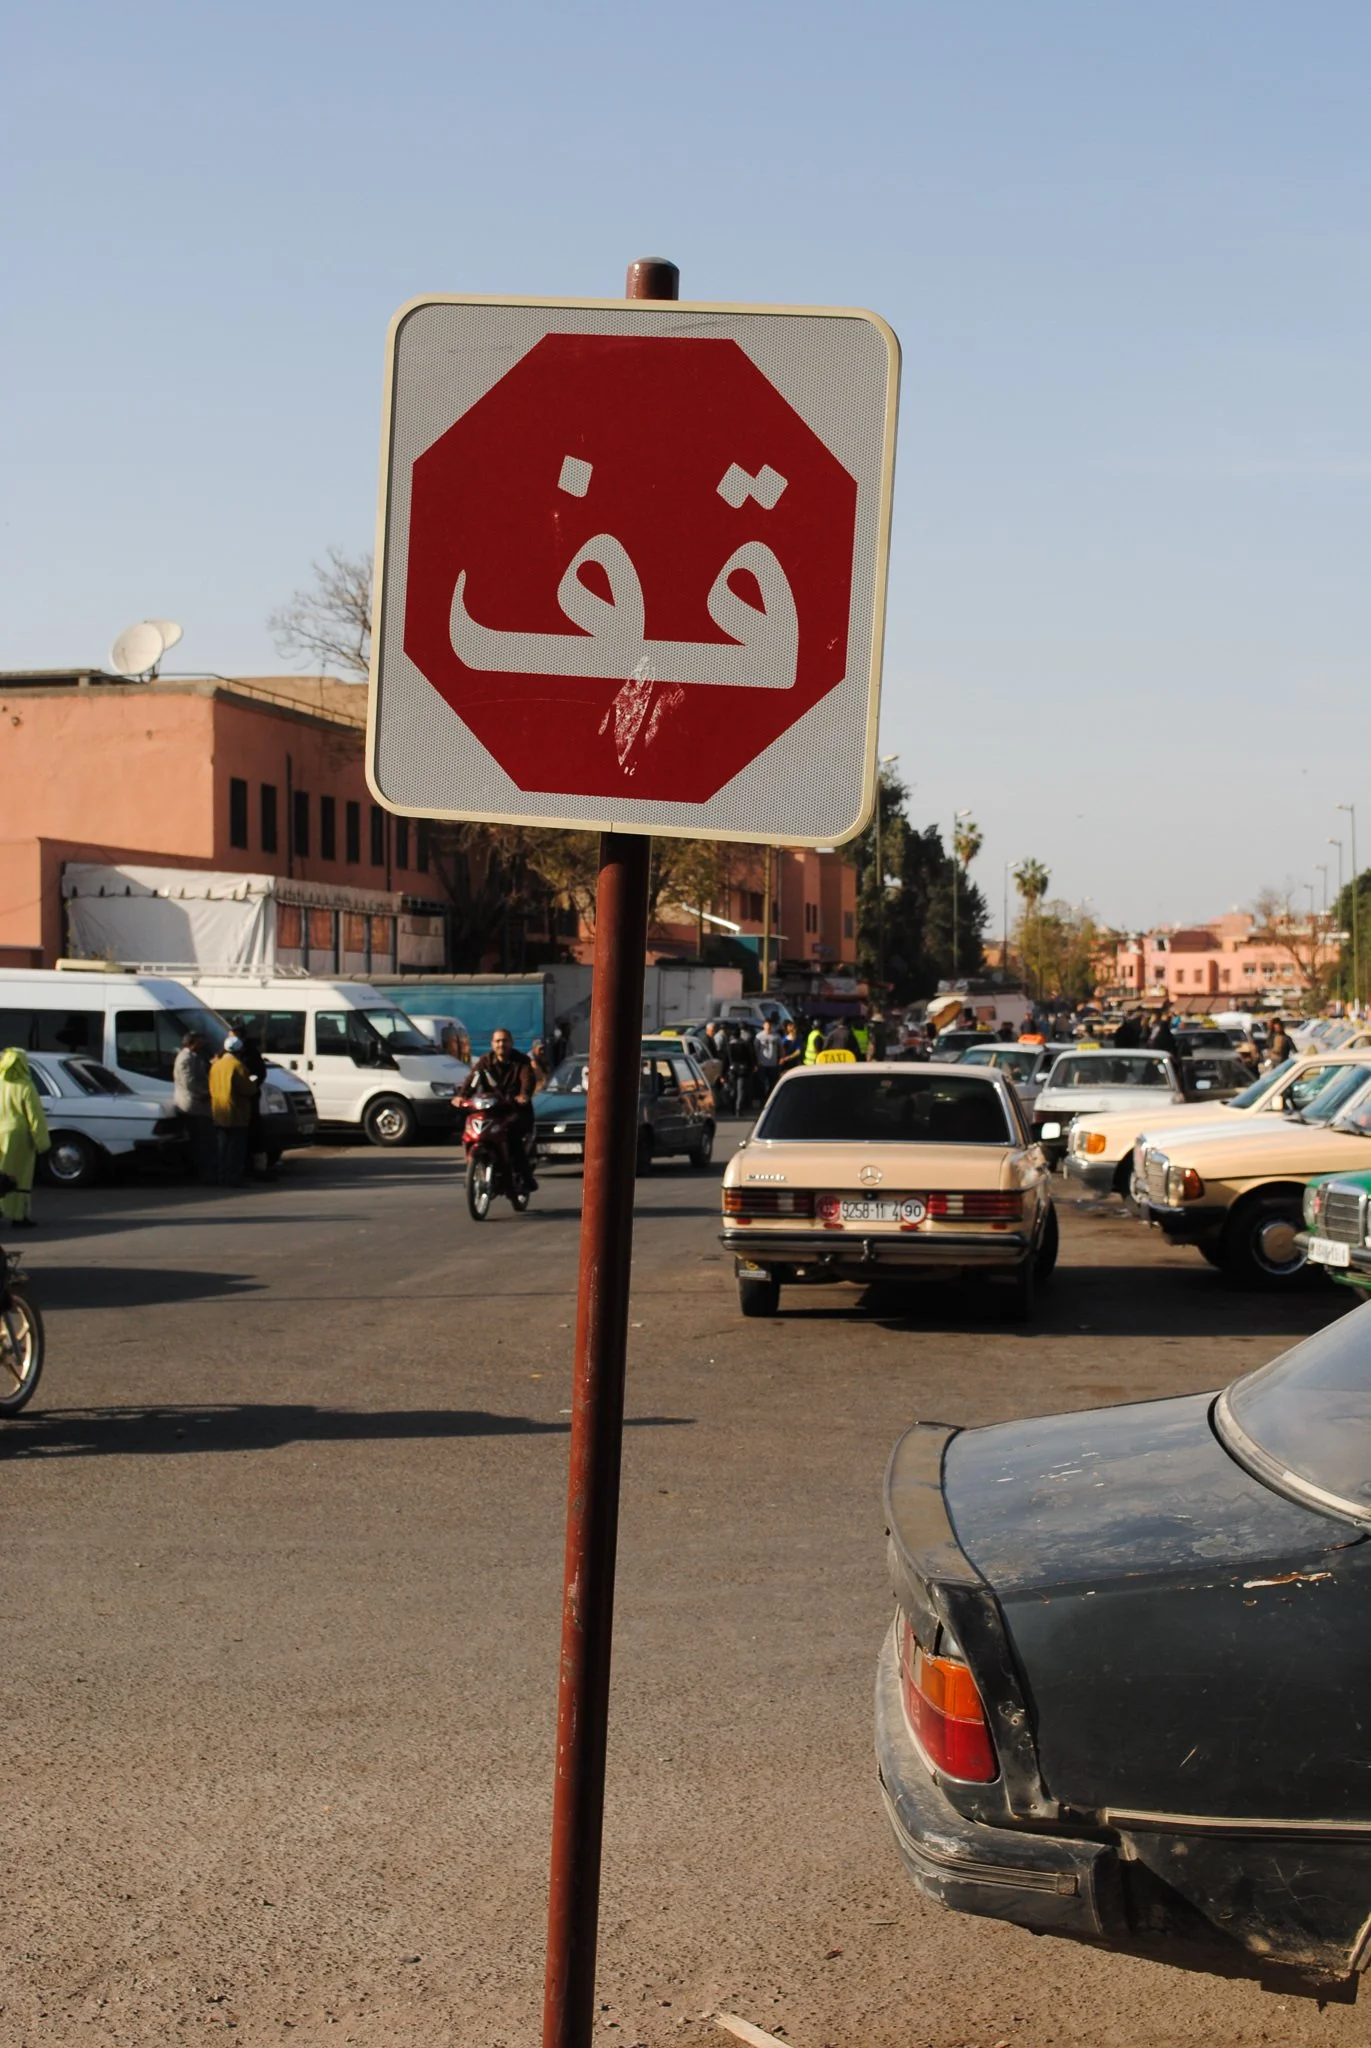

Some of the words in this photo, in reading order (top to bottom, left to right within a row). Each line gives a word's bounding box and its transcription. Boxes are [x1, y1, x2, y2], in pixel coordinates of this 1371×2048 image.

[449, 455, 799, 689] قف
[823, 1053, 847, 1064] TAXI
[904, 1204, 922, 1217] 90
